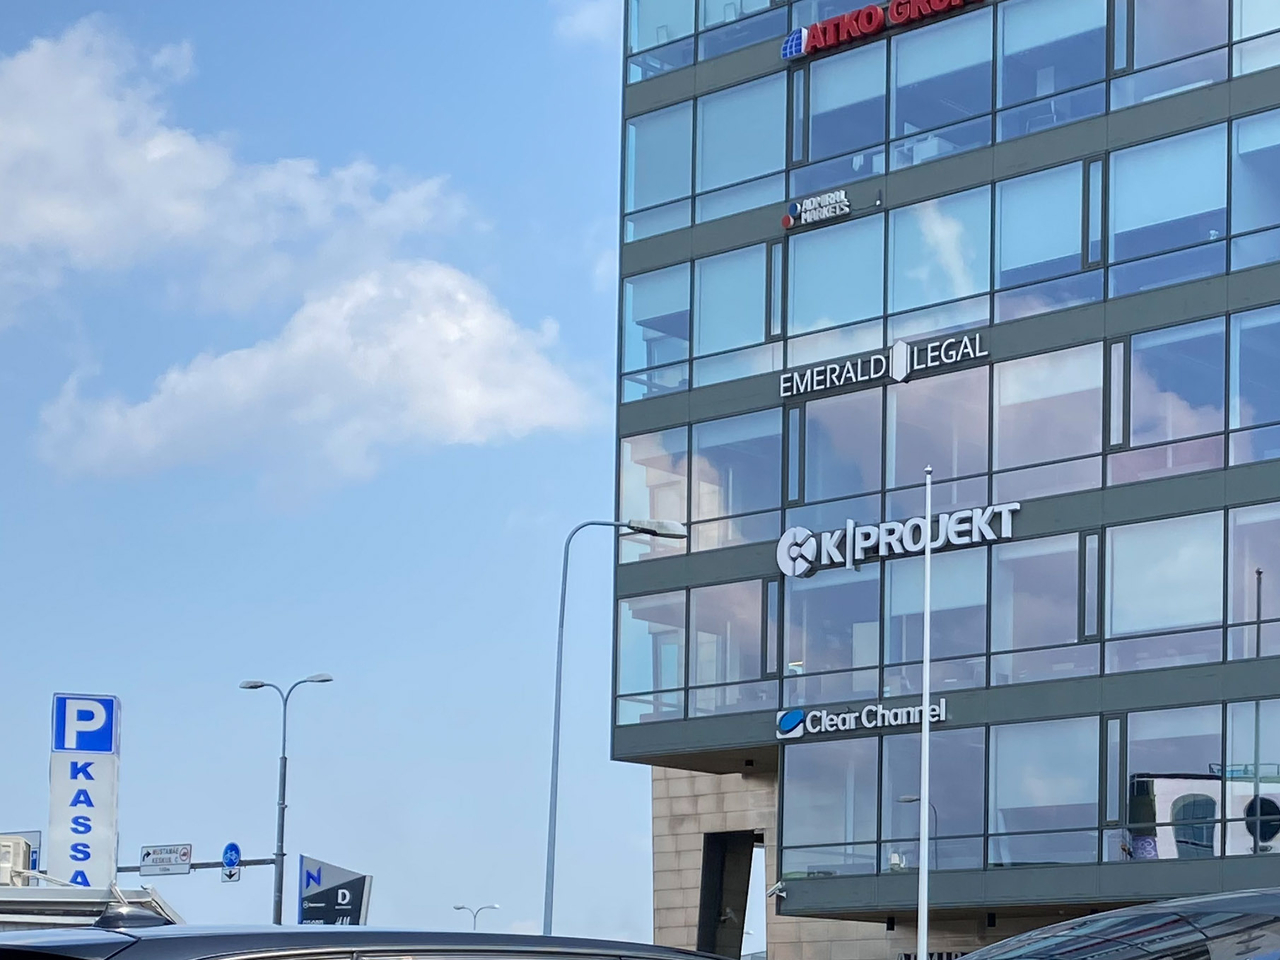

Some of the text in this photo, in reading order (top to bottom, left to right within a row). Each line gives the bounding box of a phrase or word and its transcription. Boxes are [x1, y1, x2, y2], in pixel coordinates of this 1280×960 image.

[805, 5, 885, 54] ATKO
[801, 190, 848, 211] ADMIRAL
[801, 201, 850, 224] MARKETS
[780, 333, 989, 397] EMERALD LEGAL
[64, 698, 107, 749] P
[805, 698, 946, 733] Clear Channel
[69, 761, 95, 887] KASSA
